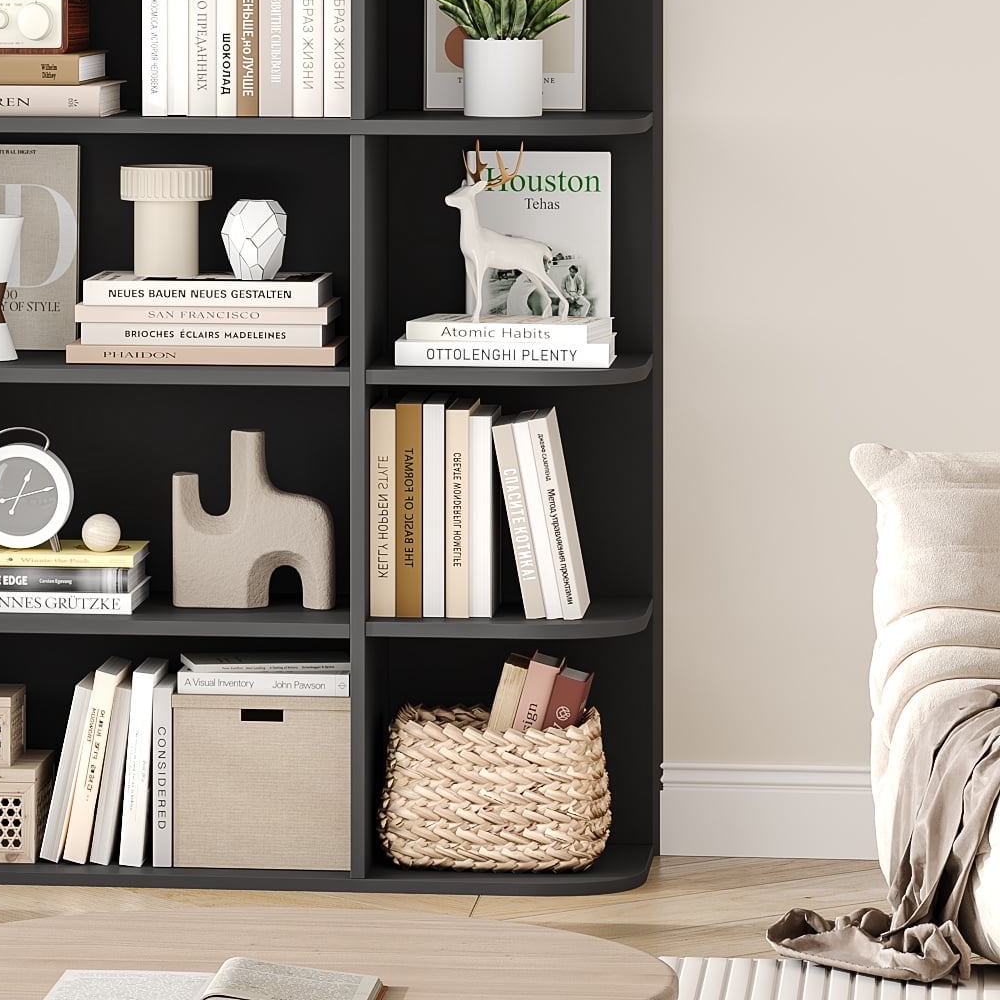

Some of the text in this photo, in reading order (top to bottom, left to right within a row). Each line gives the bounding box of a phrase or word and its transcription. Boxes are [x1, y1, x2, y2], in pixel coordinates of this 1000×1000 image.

[197, 1, 207, 10] О
[197, 13, 207, 92] ПРЕДАННЫХ
[221, 33, 231, 95] ШОКОЛАД
[302, 37, 314, 90] ЖИЗНИ
[334, 37, 345, 90] ЖИЗНИ
[485, 167, 601, 193] Houston
[524, 198, 560, 210] Tehas
[108, 289, 292, 299] NEUES BAUEN NEUES GESTALTEN
[9, 301, 24, 312] OF
[26, 301, 61, 312] STYLE
[147, 310, 260, 320] SAN FRANCISCO
[124, 328, 287, 340] BRIOCHES ÉCLAIRS MADELEINES
[441, 326, 551, 339] Atomic Habits
[103, 351, 177, 359] PHAIDON
[426, 348, 577, 362] OTTOLENGHI PLENTY
[504, 468, 537, 581] СПАСИТЕ КОТИКА!
[3, 576, 28, 586] EDGE
[44, 595, 121, 610] GRÜTZKE
[184, 678, 255, 689] A Visual Inventory
[272, 680, 326, 690] John Pawson
[158, 726, 167, 830] CONSIDERED
